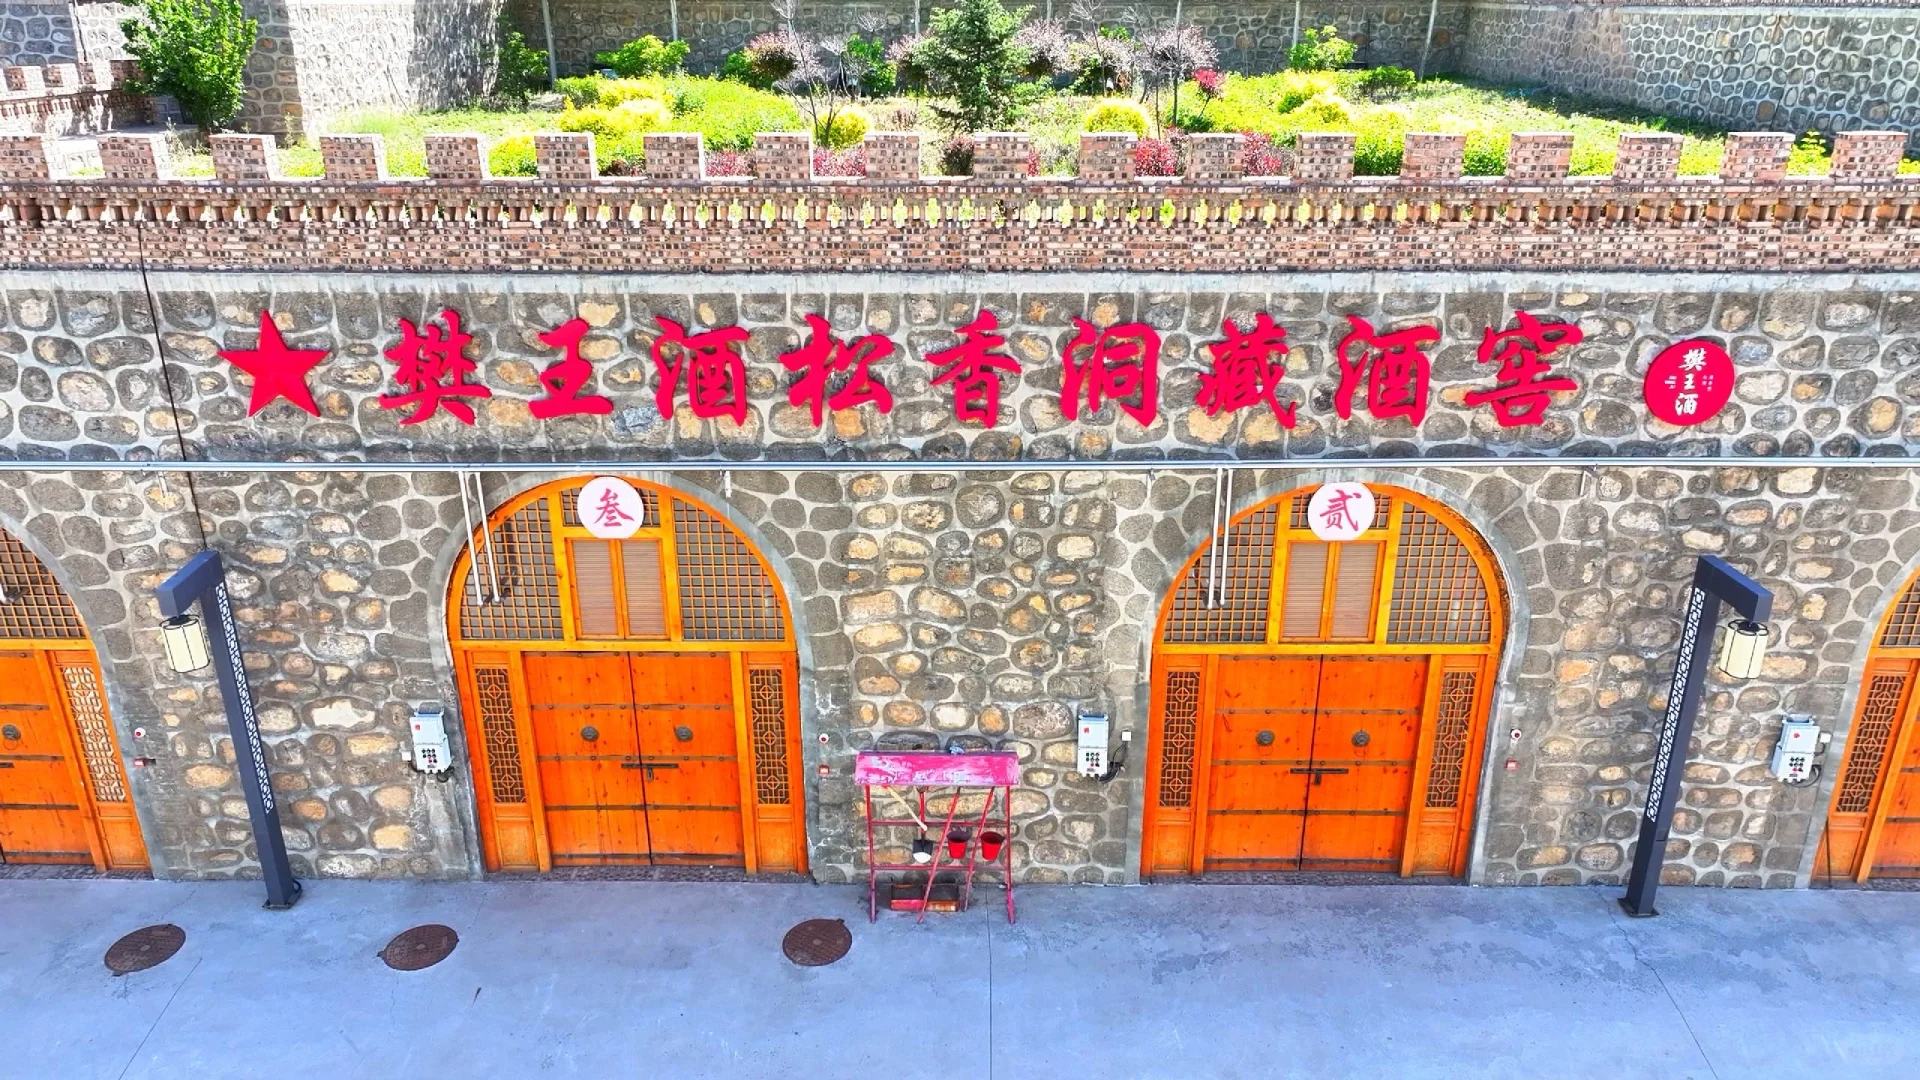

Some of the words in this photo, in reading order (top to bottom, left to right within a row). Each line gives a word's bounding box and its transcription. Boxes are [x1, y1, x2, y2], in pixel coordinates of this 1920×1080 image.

[379, 310, 1583, 429] 樊王酒松香洞藏酒窖
[1675, 348, 1707, 415] 樊王酒
[593, 488, 635, 527] 叁
[1320, 489, 1362, 532] 贰
